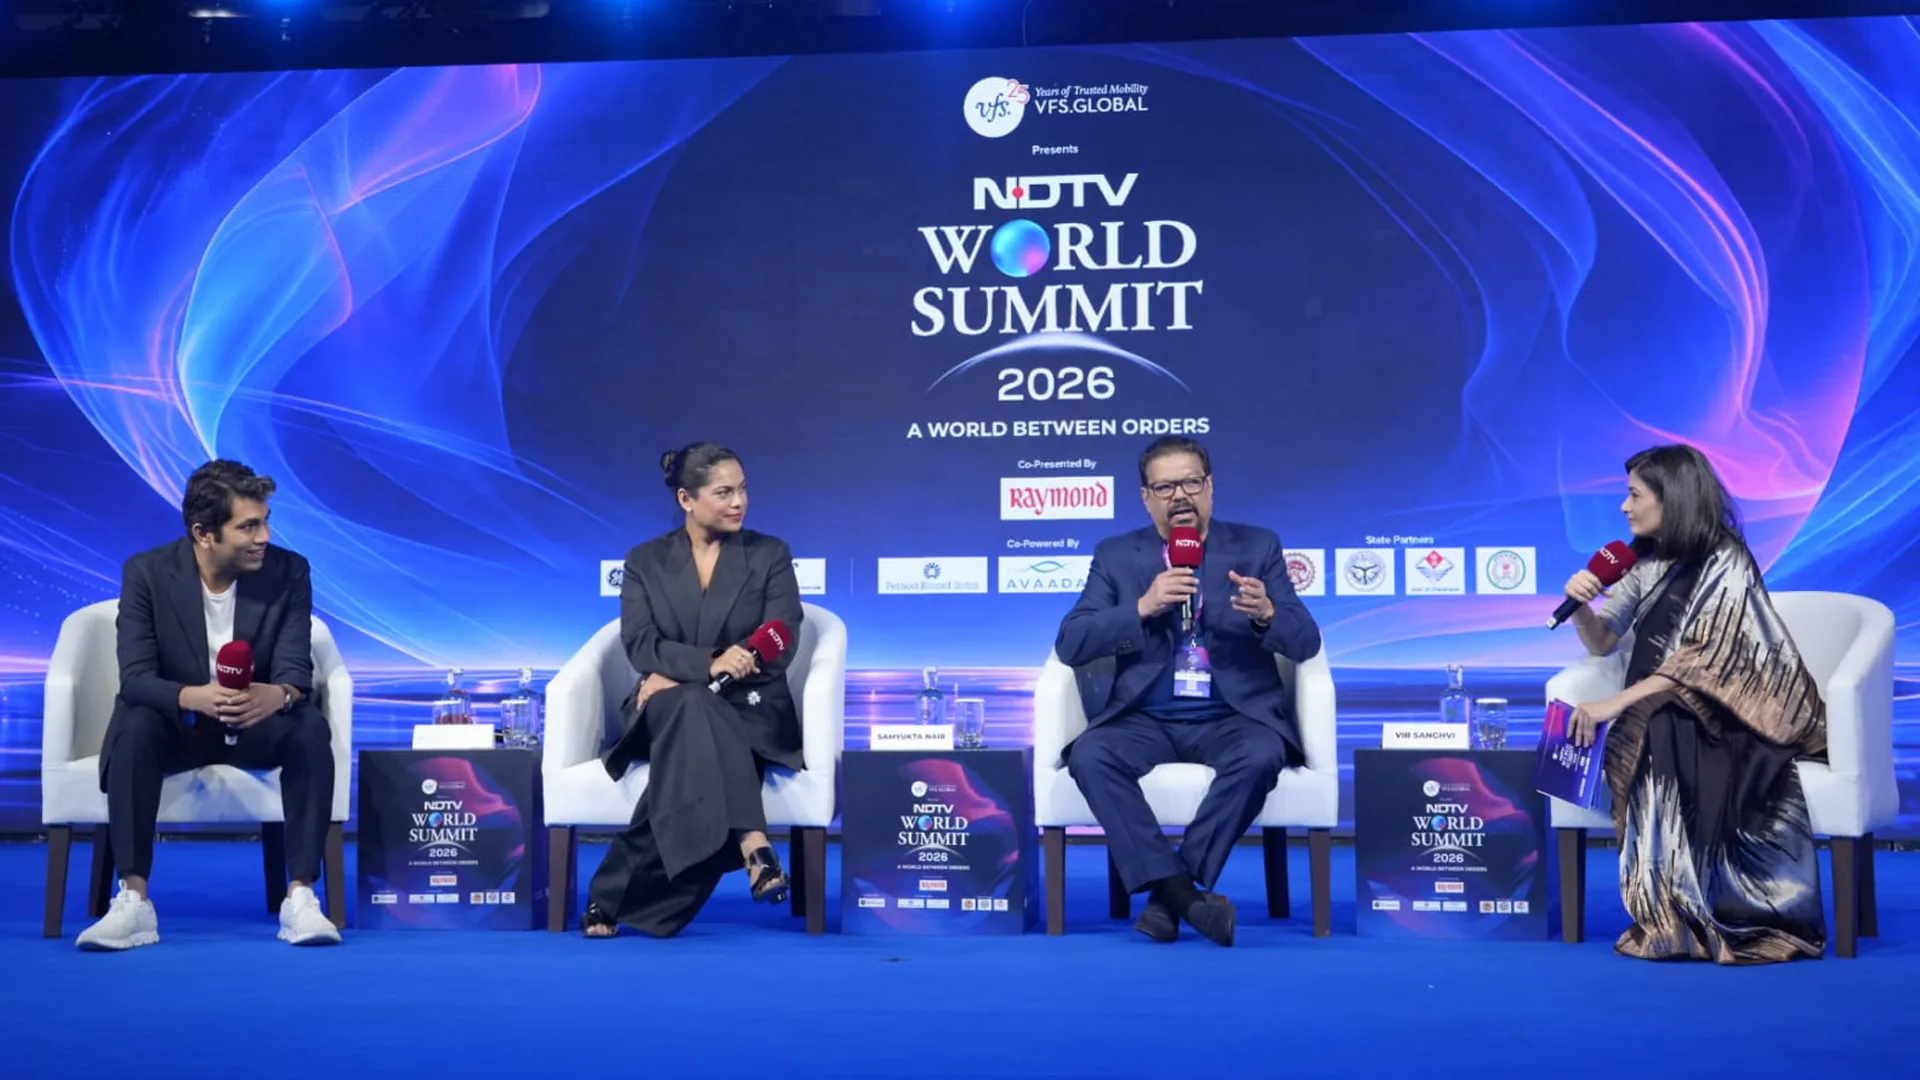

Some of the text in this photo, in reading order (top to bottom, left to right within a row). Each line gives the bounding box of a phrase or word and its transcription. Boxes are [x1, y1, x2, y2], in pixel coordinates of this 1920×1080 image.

[1007, 79, 1149, 104] 25 Years of Trusted Mobility
[1035, 96, 1149, 114] VFS.GLOBAL
[1032, 145, 1079, 155] Presents
[973, 173, 1138, 210] NDTV
[917, 220, 1197, 278] WORLD
[911, 280, 1204, 337] SUMMIT
[998, 366, 1116, 402] 2026
[906, 417, 1210, 438] A WORLD BETWEEN ORDERS
[1017, 459, 1097, 470] Co-Presented By
[1006, 538, 1080, 549] Co-Powered By
[1175, 539, 1200, 548] NDTV
[1365, 535, 1434, 545] State Partners
[1006, 577, 1086, 590] AVAADA
[768, 627, 785, 651] NDTV
[1413, 732, 1456, 740] SANGHVI
[423, 800, 463, 811] NDTV
[913, 803, 955, 814] NDTV
[1425, 803, 1469, 814] NDTV
[411, 812, 477, 828] WORLD
[900, 815, 969, 831] WORLD
[1412, 815, 1484, 831] WORLD
[408, 827, 478, 843] SUMMIT
[897, 831, 970, 847] SUMMIT
[1411, 832, 1486, 848] SUMMIT
[428, 848, 458, 858] 2026
[918, 852, 949, 863] 2026
[1433, 853, 1465, 864] 2026
